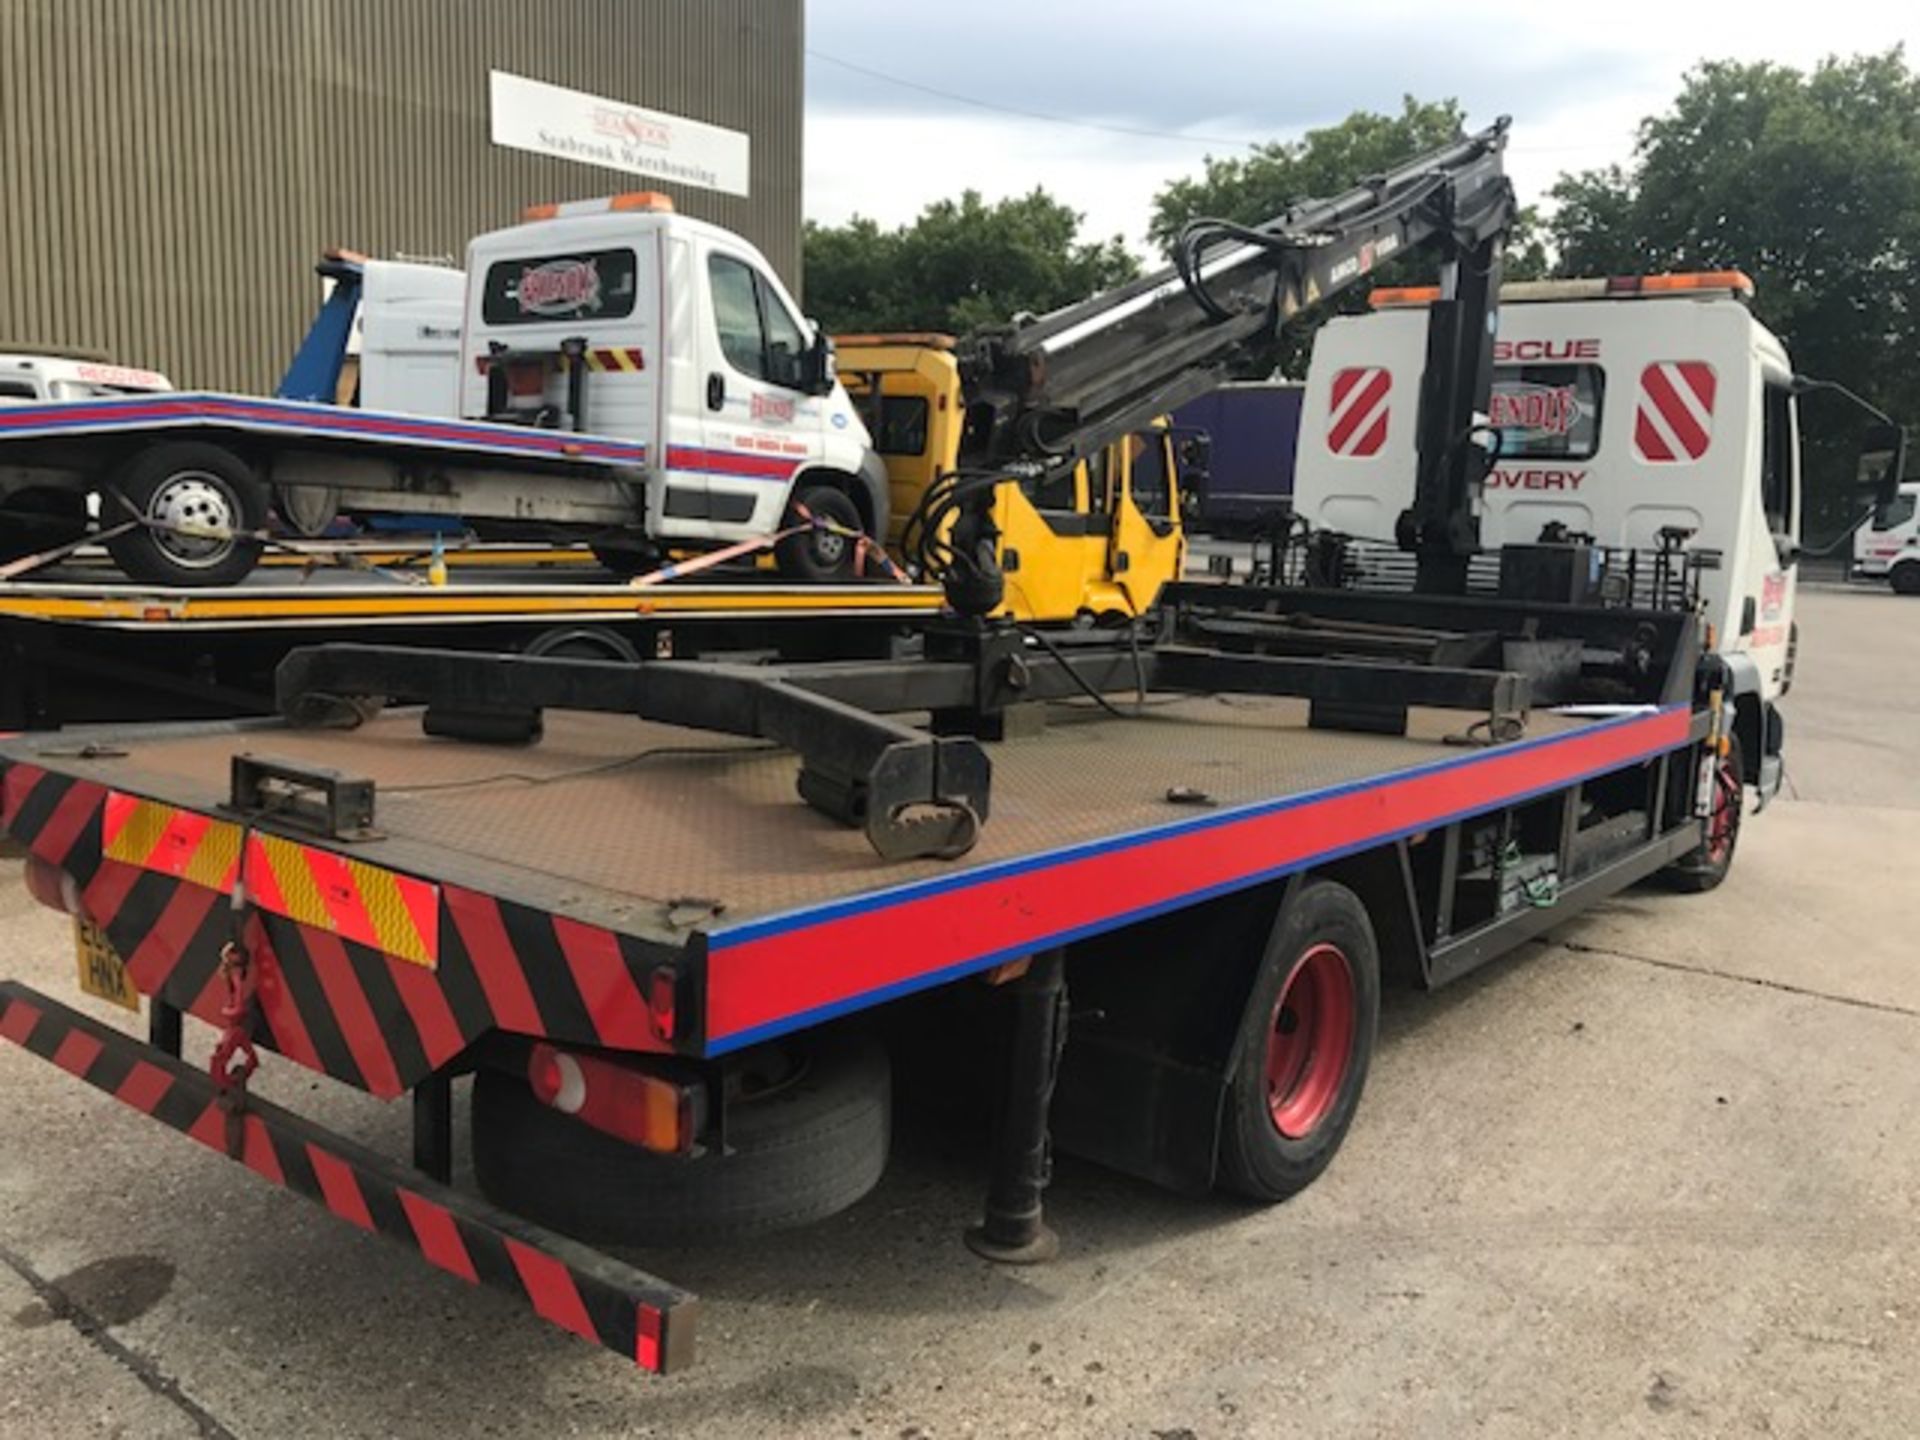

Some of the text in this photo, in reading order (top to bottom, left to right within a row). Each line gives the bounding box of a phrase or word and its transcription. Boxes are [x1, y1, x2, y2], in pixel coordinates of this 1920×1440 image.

[537, 130, 717, 186] Seabrook Warehousing
[1494, 339, 1600, 361] SCUE
[1490, 385, 1577, 434] ENDLY
[1486, 470, 1587, 490] OVERY
